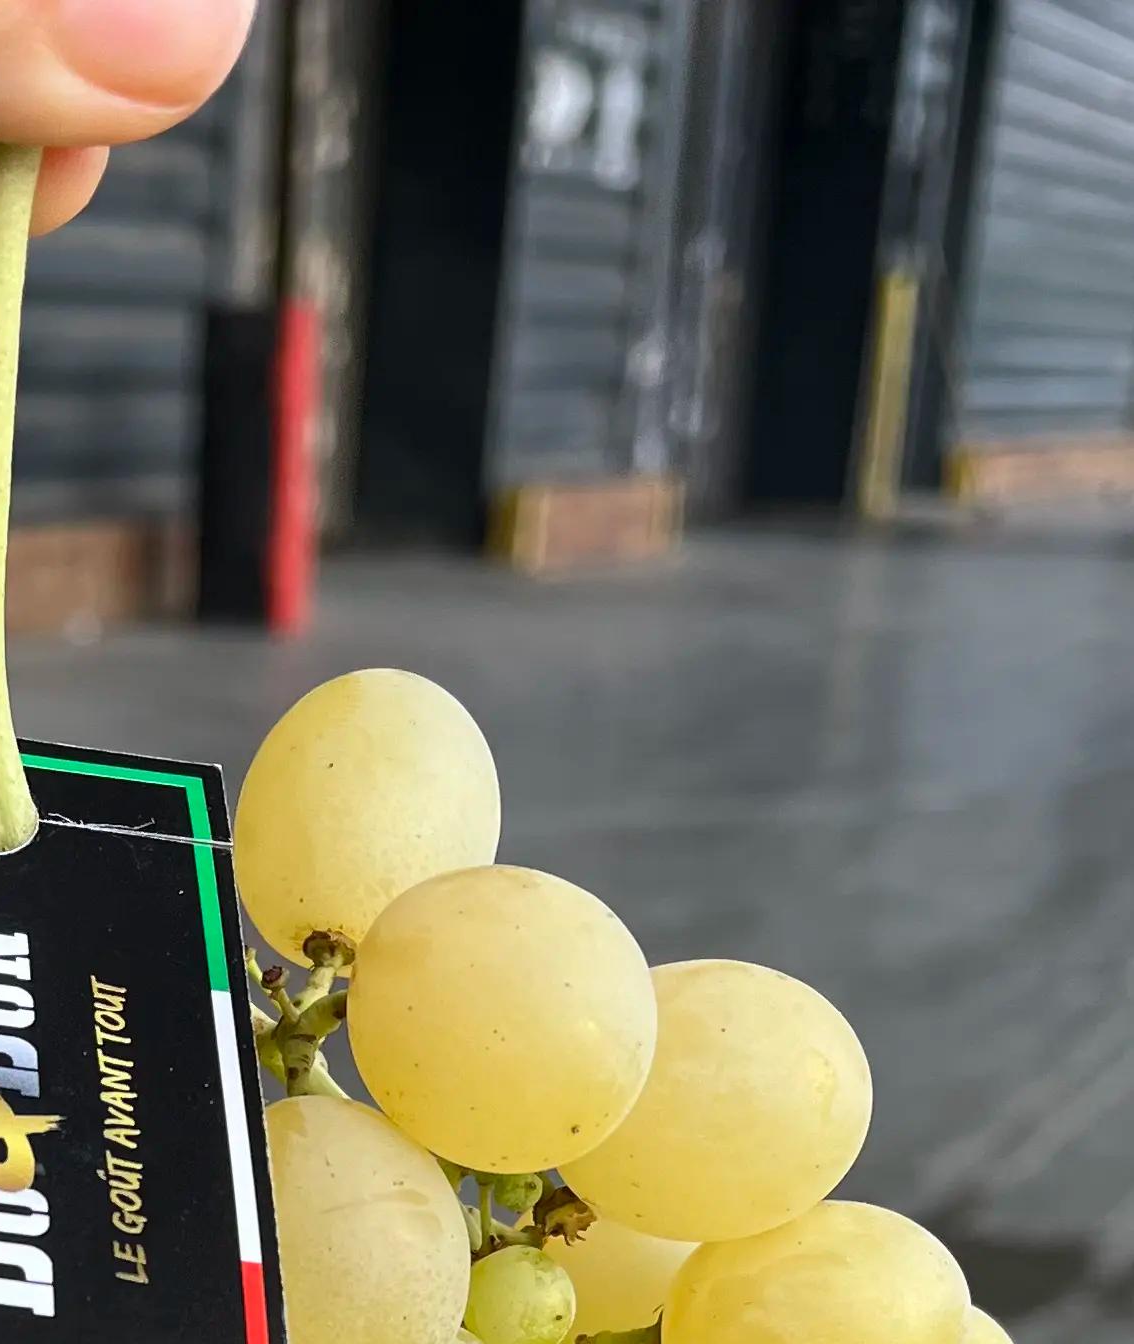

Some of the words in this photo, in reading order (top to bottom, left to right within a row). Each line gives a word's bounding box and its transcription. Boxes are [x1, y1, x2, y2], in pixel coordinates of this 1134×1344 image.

[89, 974, 132, 1046] TOUT
[96, 1047, 141, 1150] AVANT
[96, 1149, 148, 1235] GOÛT
[112, 1241, 149, 1285] LE
